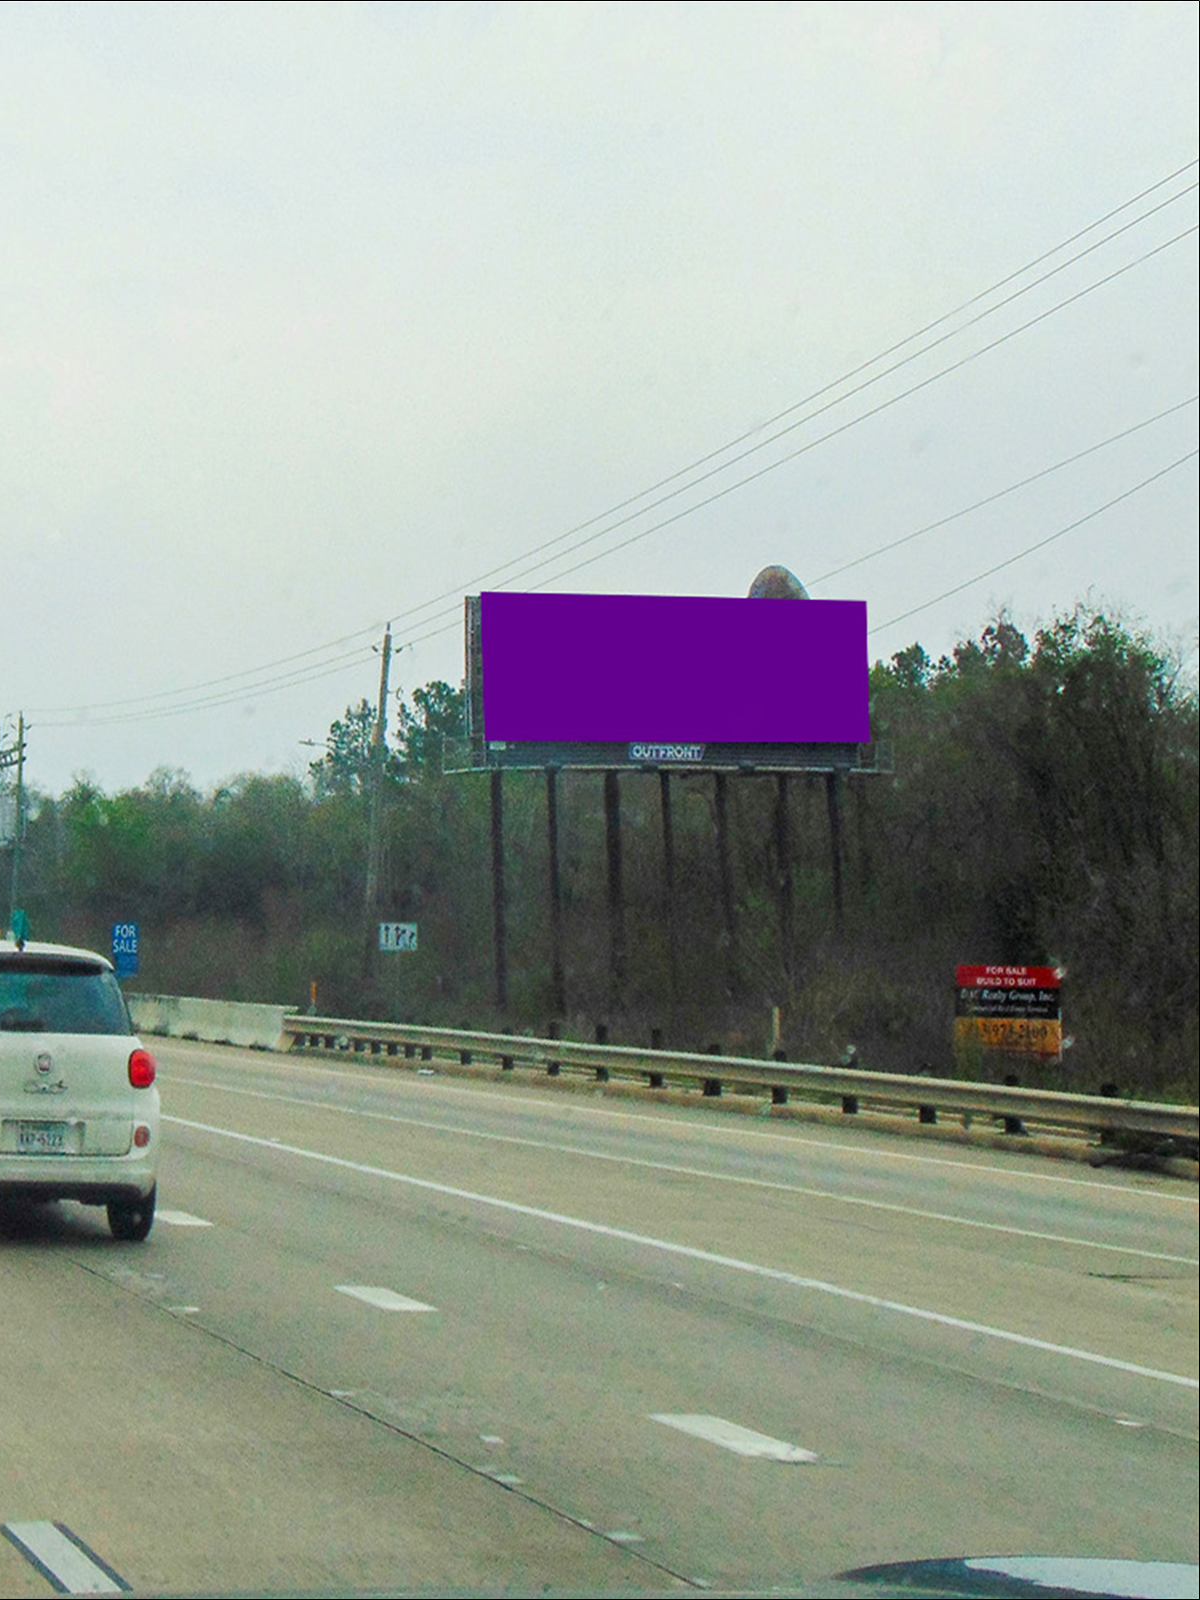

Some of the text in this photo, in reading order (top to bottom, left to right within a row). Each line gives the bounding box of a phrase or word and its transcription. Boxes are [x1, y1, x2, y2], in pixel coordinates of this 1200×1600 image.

[632, 745, 700, 760] OUTFRONT
[115, 925, 136, 938] FOR
[113, 939, 137, 953] SALE
[986, 966, 1027, 976] FOR SALE
[1004, 977, 1016, 986] TO
